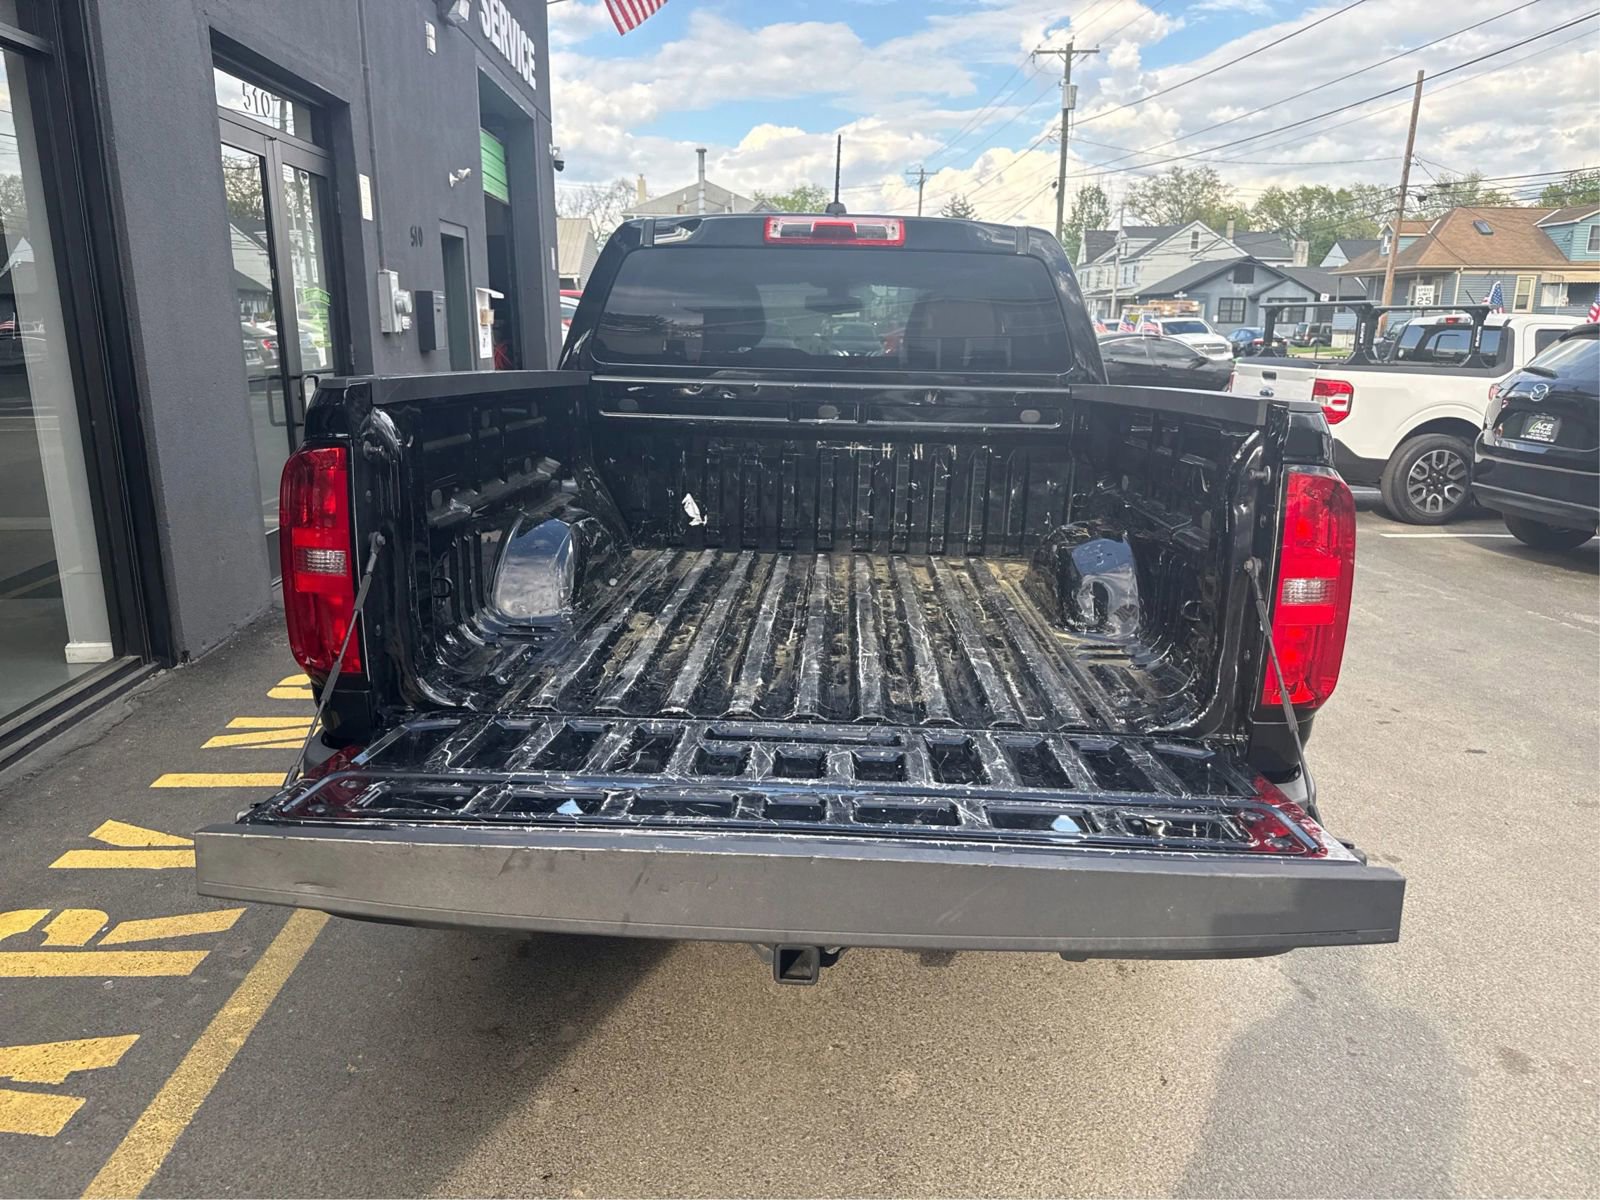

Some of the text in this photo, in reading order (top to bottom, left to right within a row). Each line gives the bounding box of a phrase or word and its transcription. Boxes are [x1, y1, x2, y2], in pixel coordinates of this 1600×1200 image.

[479, 0, 536, 90] SERVICE
[242, 82, 270, 118] 510
[409, 225, 423, 248] 510
[1417, 296, 1432, 305] 25
[1534, 422, 1555, 432] ACE
